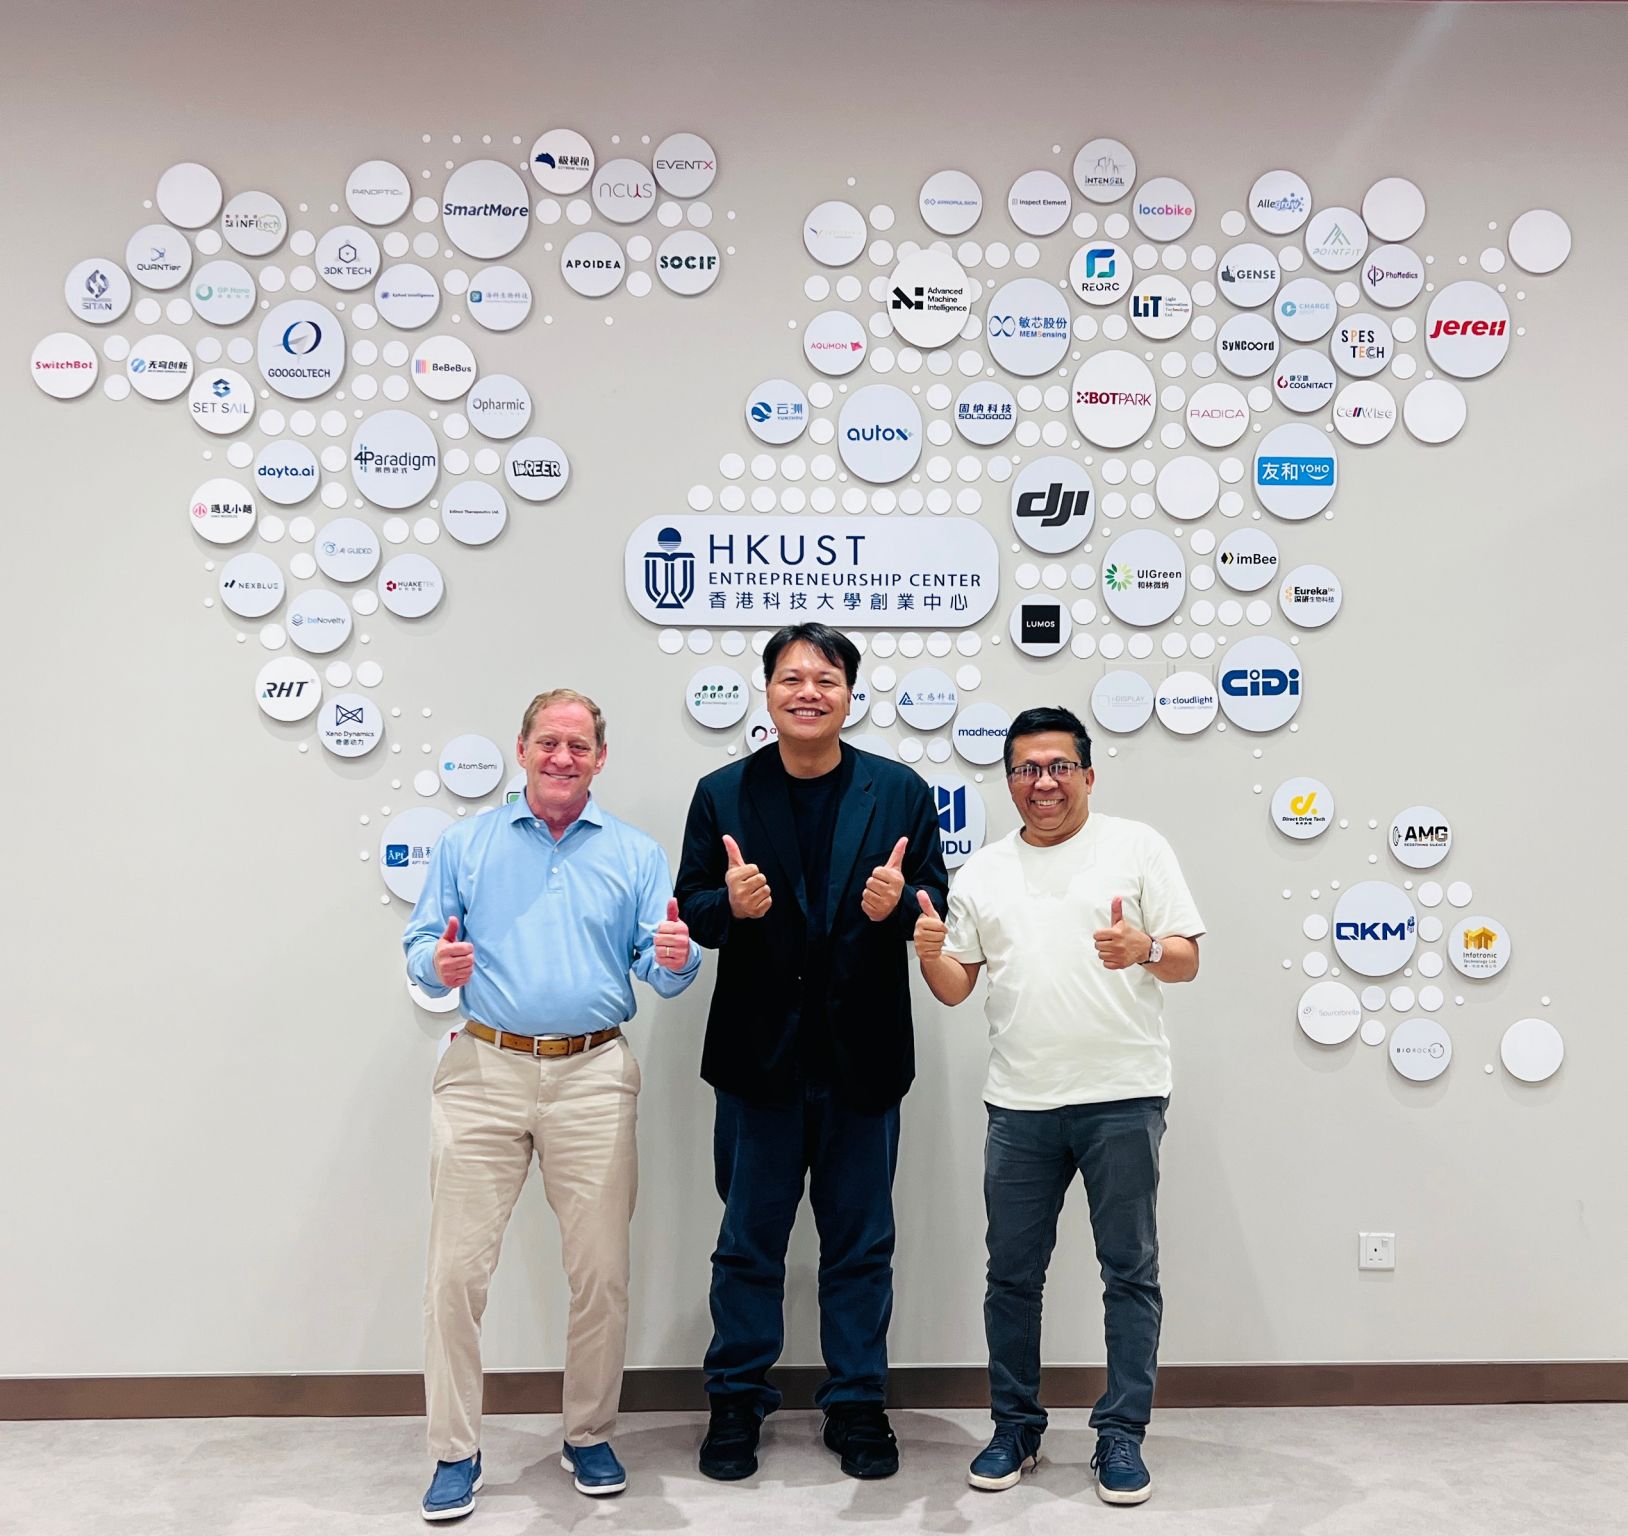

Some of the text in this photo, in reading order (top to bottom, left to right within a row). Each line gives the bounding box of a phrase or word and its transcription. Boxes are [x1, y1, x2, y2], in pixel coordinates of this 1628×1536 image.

[656, 160, 713, 170] EVENTX
[1019, 199, 1041, 207] Inspect
[444, 204, 529, 217] SmartMore
[1139, 204, 1193, 216] locobike
[566, 260, 621, 269] APOIDEA
[660, 255, 717, 270] SOCIF
[324, 267, 372, 275] 3DK TECH
[1236, 270, 1276, 280] GENSE
[1386, 271, 1418, 280] PhoMedics
[1082, 283, 1120, 291] REORC
[928, 304, 968, 313] Intelligence
[1018, 316, 1068, 330] 敏芯股份
[1019, 331, 1067, 339] MEMSensing
[1342, 330, 1375, 343] SPES
[1350, 346, 1385, 359] TECH
[36, 361, 92, 370] SwitchBot
[432, 364, 472, 373] BeBeBus
[268, 368, 331, 378] GOOGOLTECH
[193, 402, 250, 414] SET SAIL
[472, 398, 525, 412] Opharmic
[959, 403, 1012, 414] 固纳科技
[1190, 409, 1245, 419] RADICA
[354, 449, 436, 470] 4Paradigm
[258, 465, 315, 478] dayta.ai
[1262, 462, 1329, 480] 友和 YOHO
[709, 534, 866, 566] HKUST
[1237, 554, 1277, 565] imBee
[709, 572, 981, 587] ENTREPRENEURSHIP CENTER
[1137, 570, 1182, 579] UIGreen
[1294, 587, 1328, 595] Eureka
[709, 592, 968, 611] 香港科技大學創業中心
[308, 617, 346, 625] beNovelty
[262, 682, 308, 698] RHT
[1172, 696, 1213, 705] cloudlight
[344, 731, 374, 739] Dynamics
[958, 728, 1008, 737] madhead
[1405, 826, 1448, 842] AMG
[941, 840, 972, 855] DU
[1336, 923, 1406, 941] QKM
